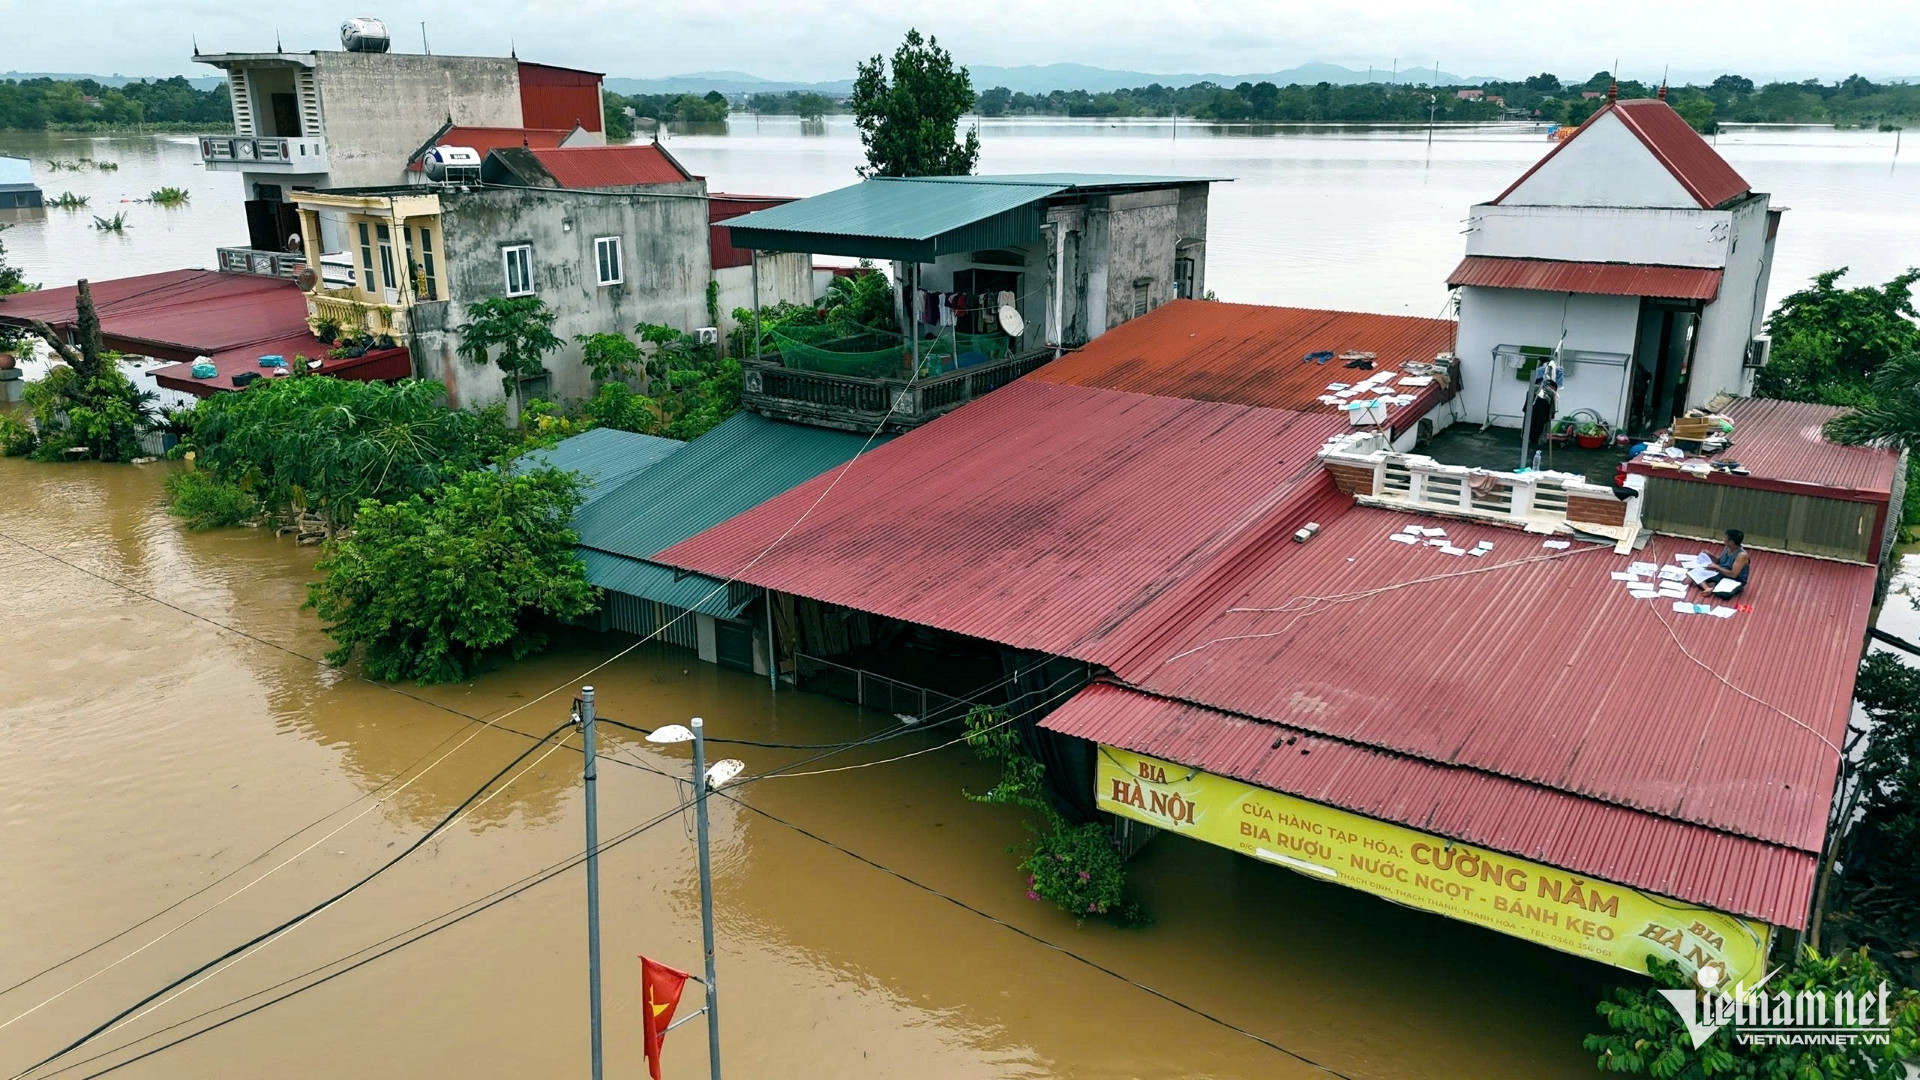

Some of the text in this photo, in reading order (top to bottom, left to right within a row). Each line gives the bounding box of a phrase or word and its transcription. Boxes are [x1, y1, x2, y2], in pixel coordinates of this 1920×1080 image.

[1138, 761, 1168, 784] BIA
[1111, 778, 1195, 826] HÀ NỘI
[1241, 802, 1620, 918] CỬA HÀNG TẠP HÓA: CƯỜNG NĂM
[1240, 821, 1272, 843] BIA
[1277, 832, 1332, 860] RƯỢU
[1350, 852, 1409, 883] NƯỚC
[1415, 872, 1475, 901] NGỌT
[1493, 895, 1559, 927] BÁNH
[1566, 915, 1615, 942] KẸO
[1638, 923, 1684, 954] HÀ
[1687, 920, 1724, 952] BIA
